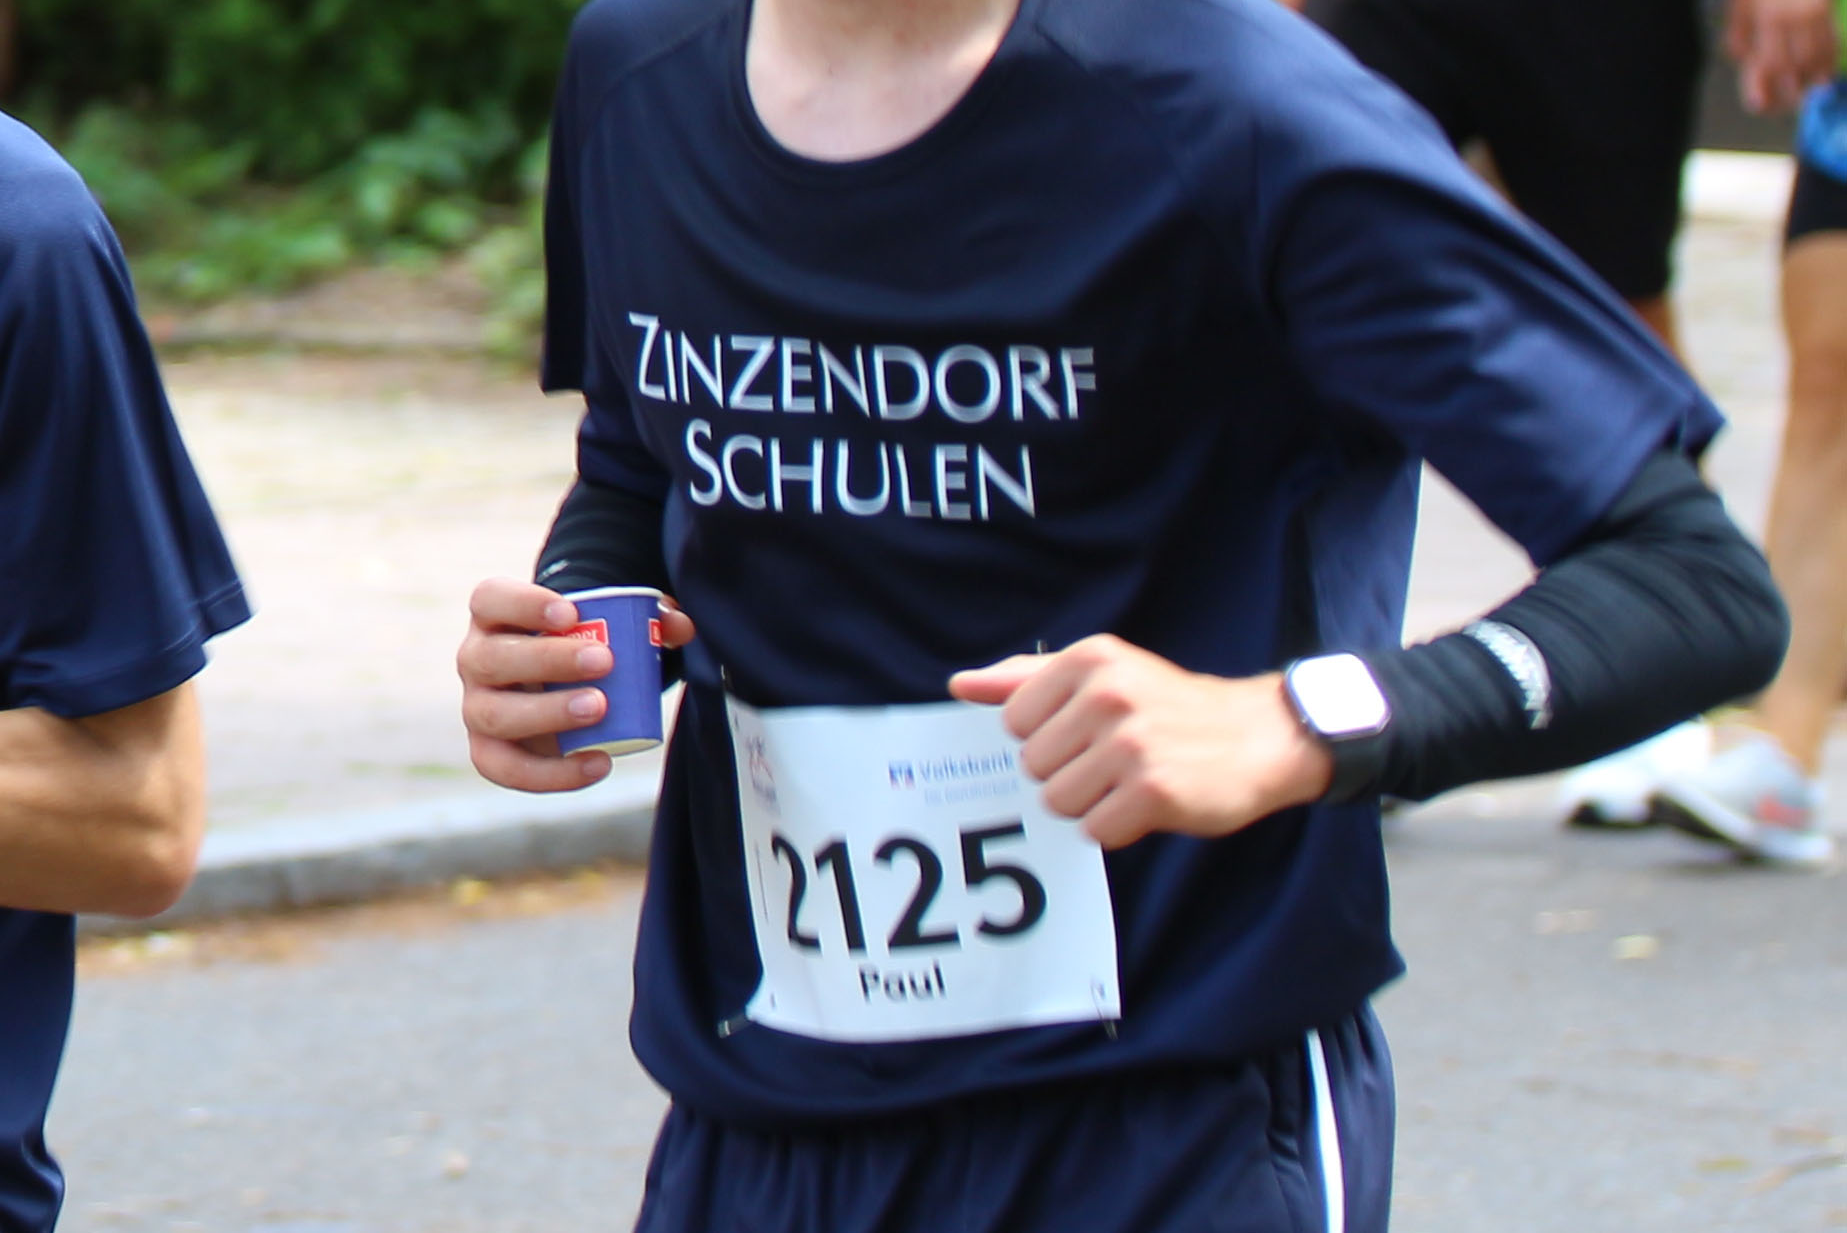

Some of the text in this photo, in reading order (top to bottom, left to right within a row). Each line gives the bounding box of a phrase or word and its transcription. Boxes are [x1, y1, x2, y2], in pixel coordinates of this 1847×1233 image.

[629, 312, 1096, 422] ZINZENDORF
[686, 419, 1035, 519] SCHULEN
[771, 822, 1047, 953] 2125
[859, 961, 946, 1002] Paul
